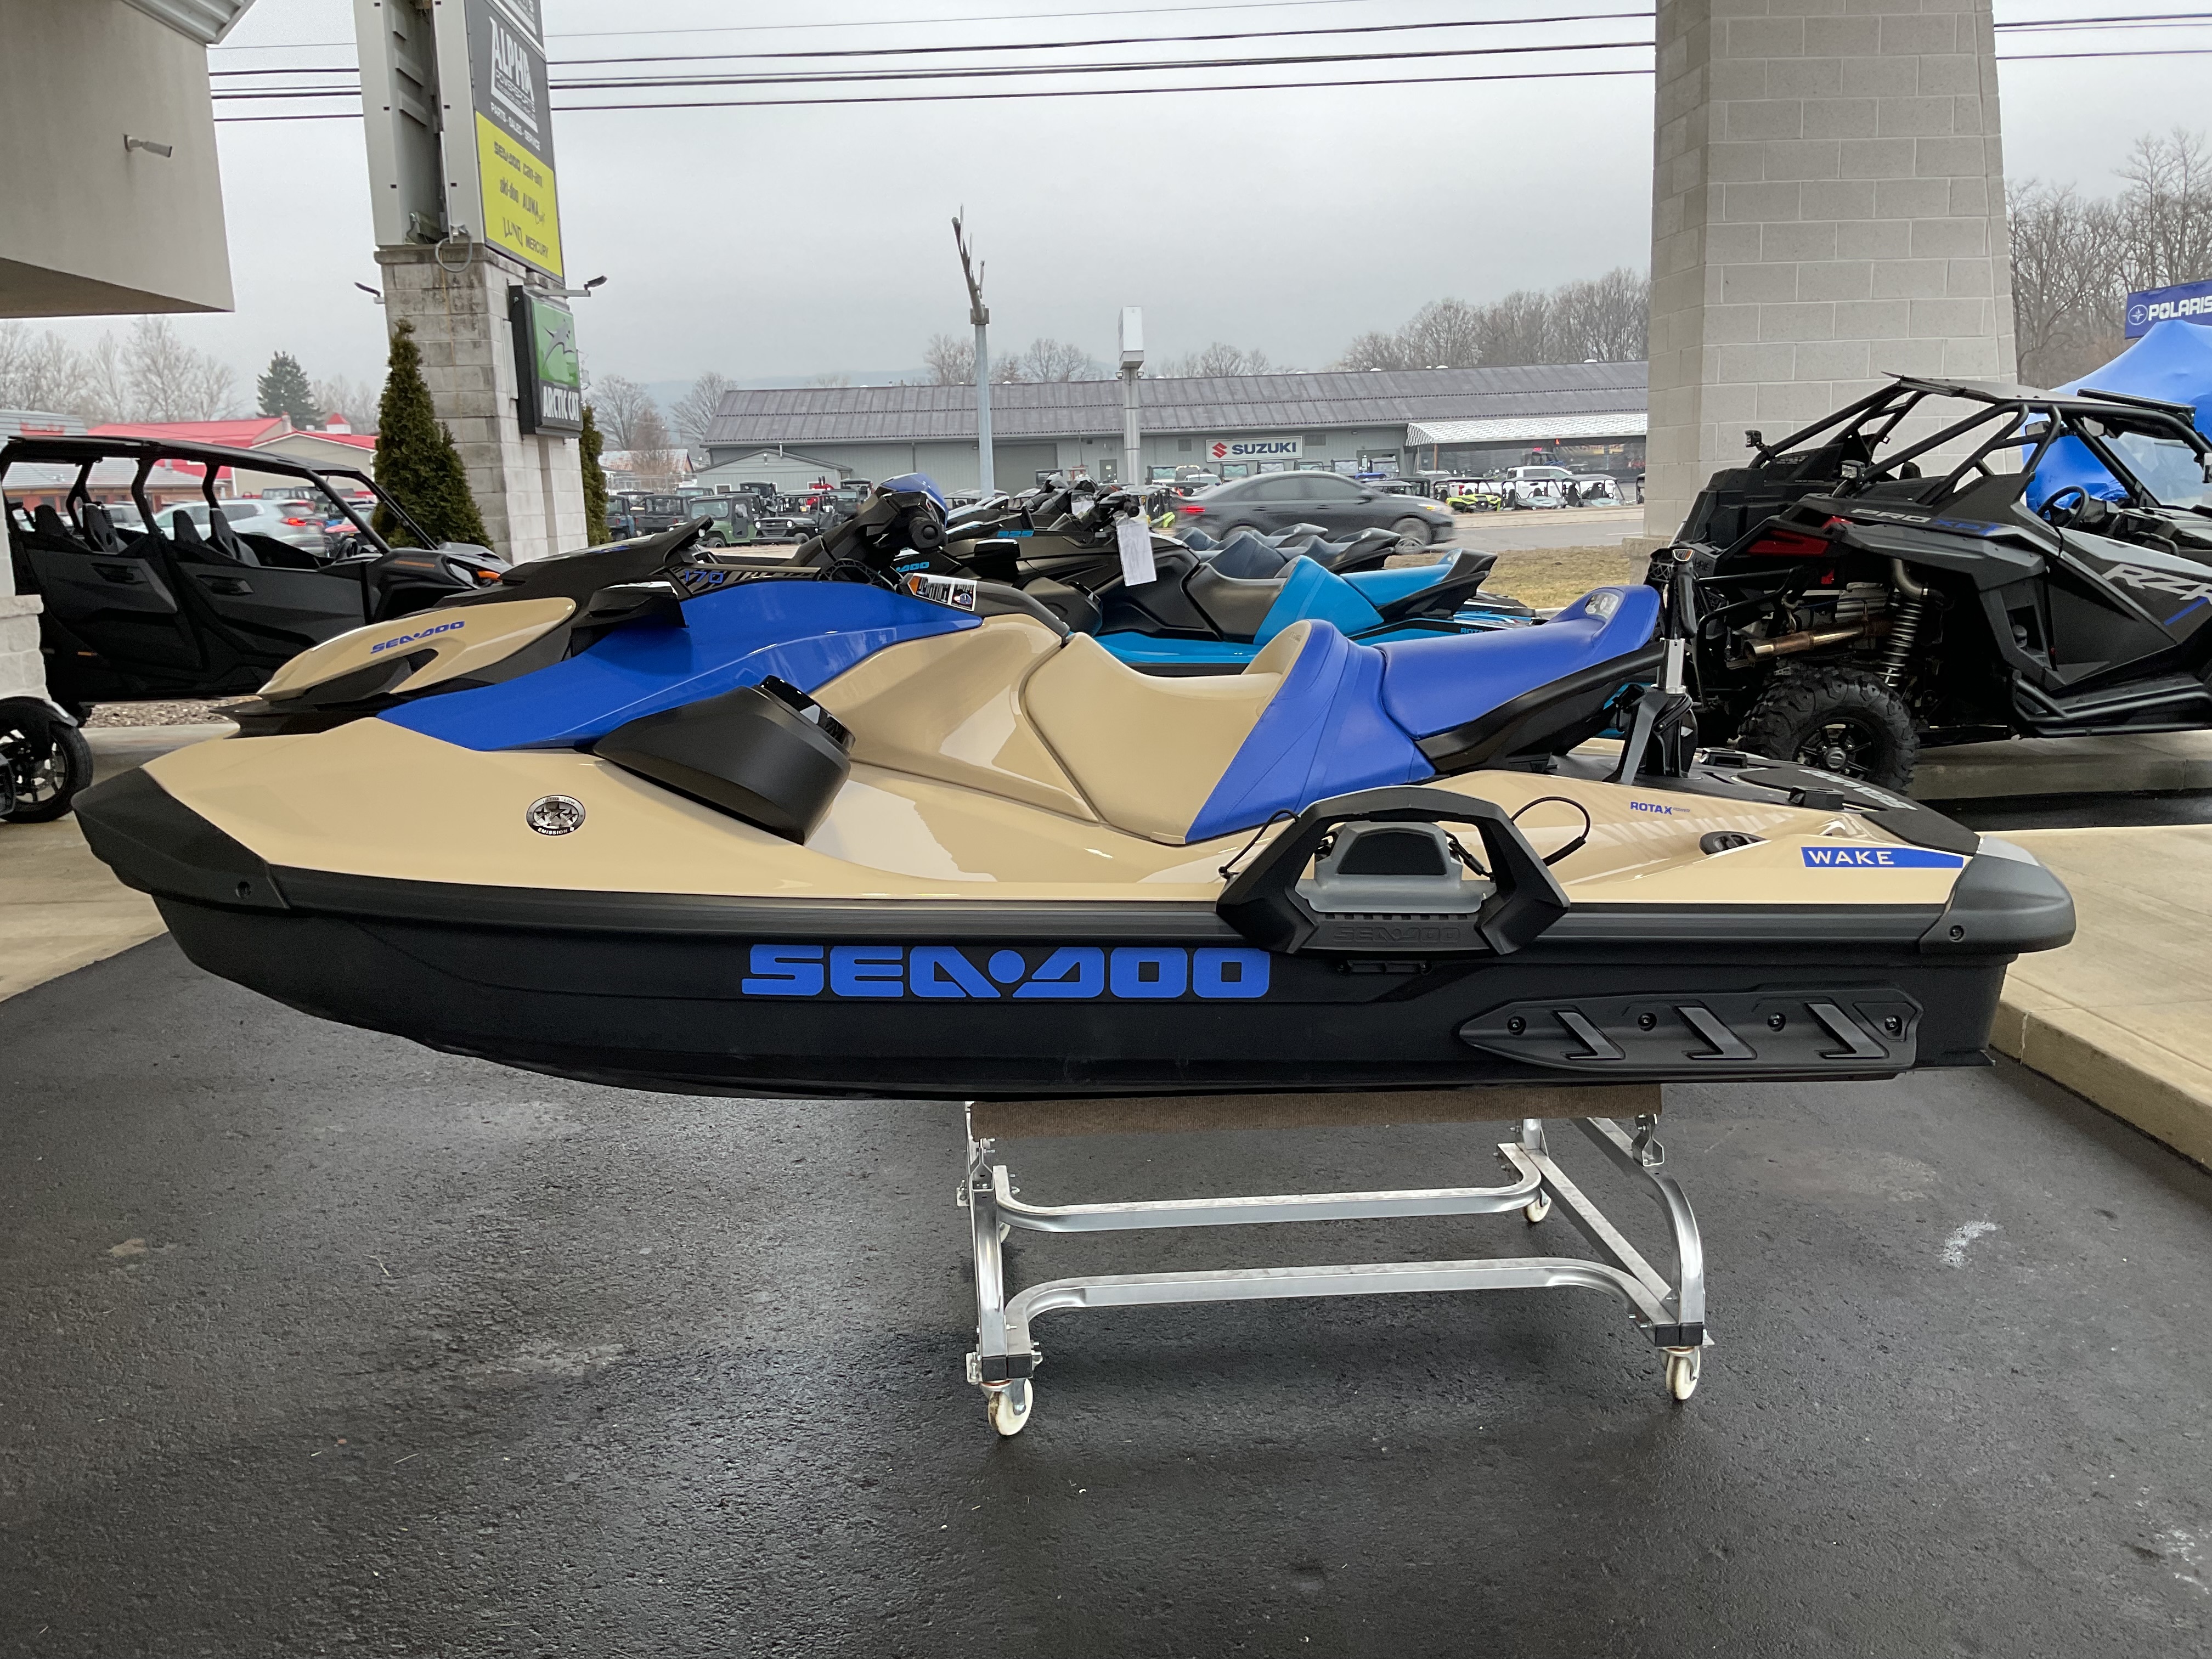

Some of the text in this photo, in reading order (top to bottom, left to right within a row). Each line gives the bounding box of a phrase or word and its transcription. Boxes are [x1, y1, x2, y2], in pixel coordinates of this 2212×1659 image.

[488, 16, 534, 103] ALPHA
[525, 234, 549, 259] MERCURY
[2148, 295, 2212, 321] POLARIS
[1232, 442, 1296, 455] SUZUKI
[1850, 508, 1932, 523] PRO
[684, 569, 724, 584] 170
[2102, 563, 2212, 605] RZR
[1630, 802, 1672, 815] ROTAX
[538, 827, 568, 835] EMISSION
[1807, 850, 1894, 865] WAKE
